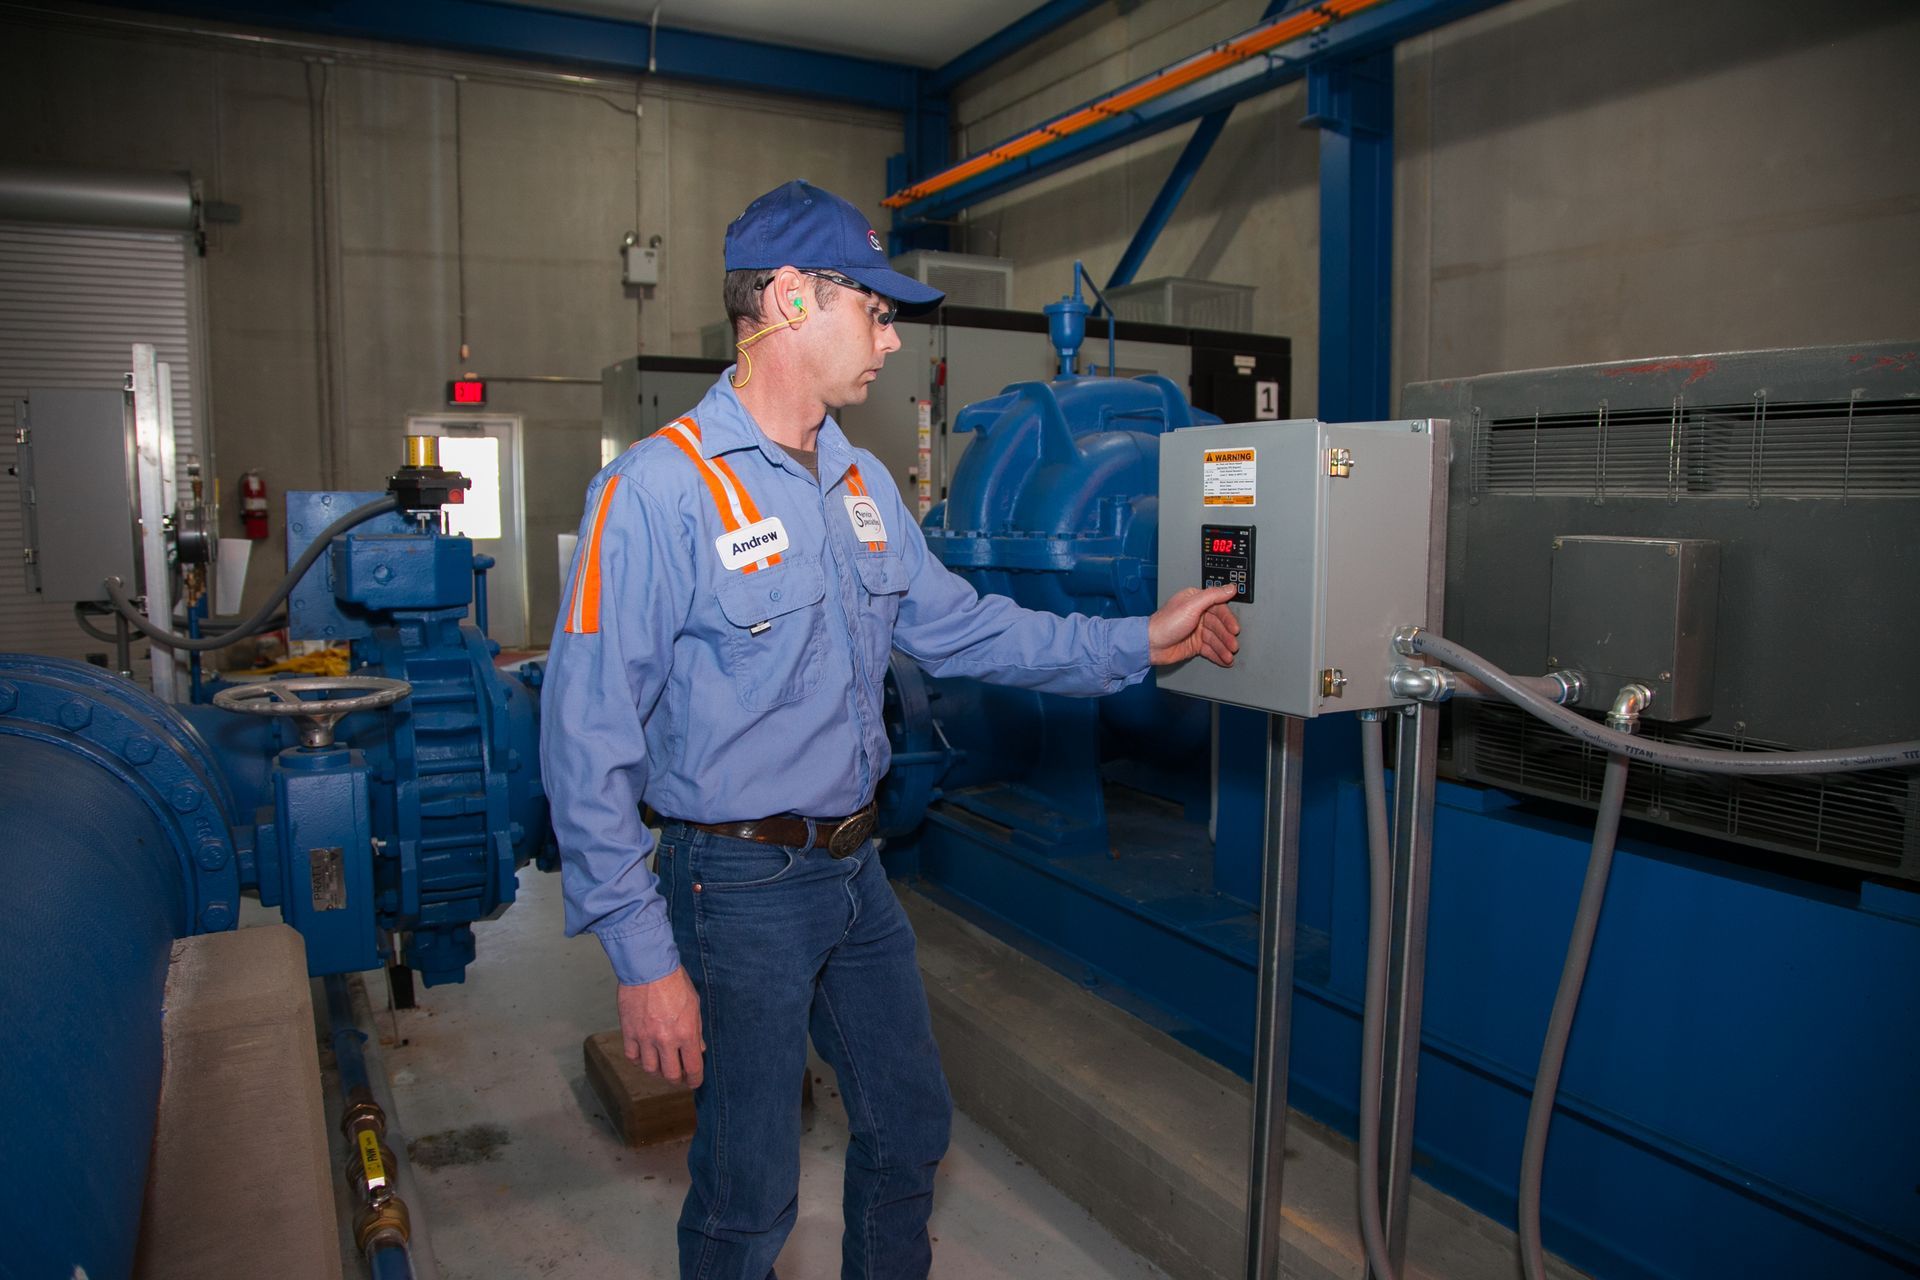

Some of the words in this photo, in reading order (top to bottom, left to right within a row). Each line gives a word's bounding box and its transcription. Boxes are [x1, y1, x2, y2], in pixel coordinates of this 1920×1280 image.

[1262, 386, 1274, 413] 1
[1215, 453, 1251, 462] WARNING
[732, 530, 778, 556] Andrew
[1212, 539, 1233, 553] 002
